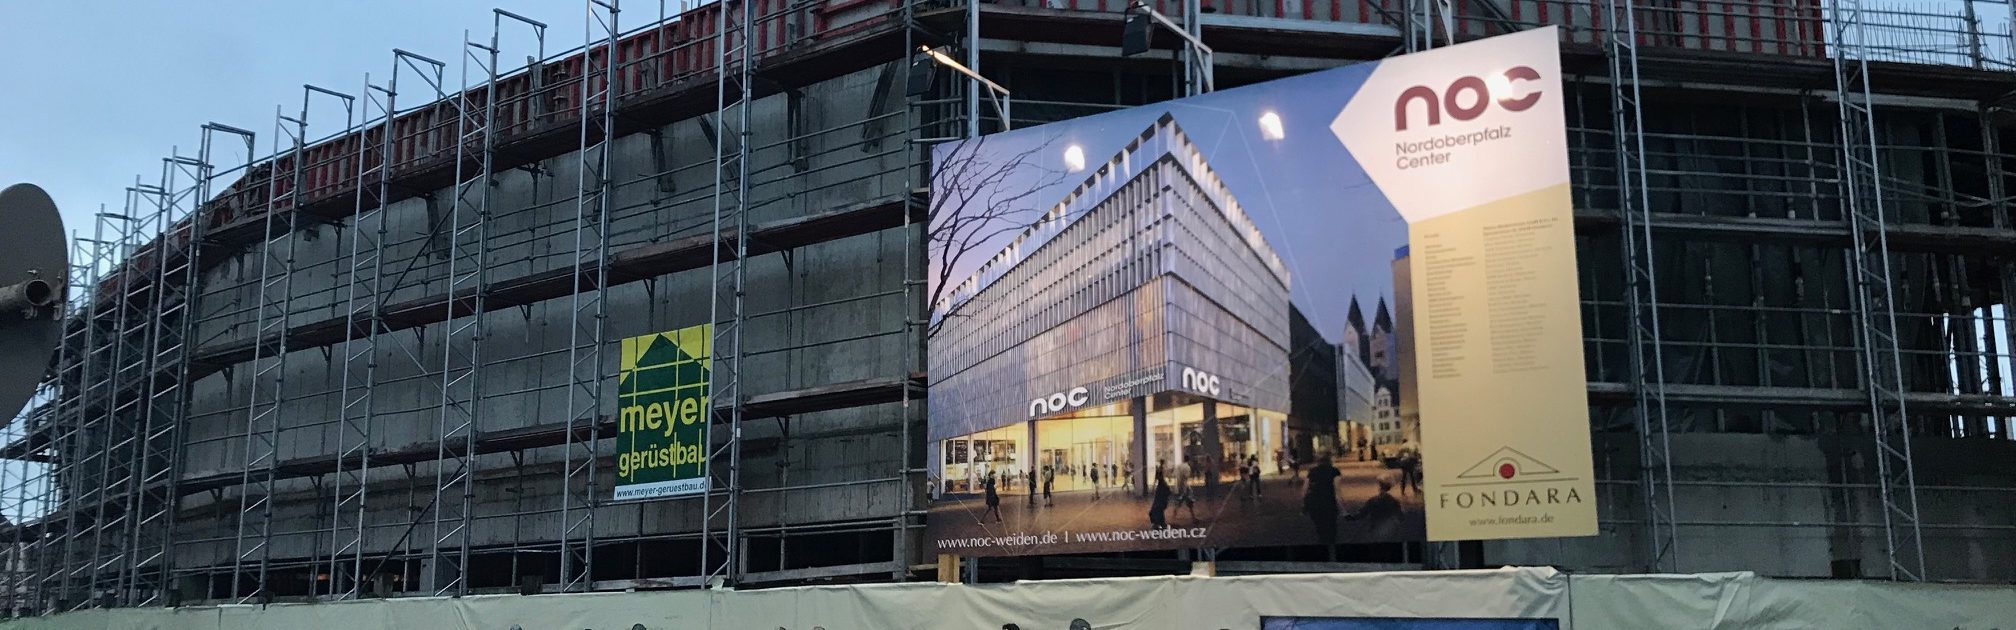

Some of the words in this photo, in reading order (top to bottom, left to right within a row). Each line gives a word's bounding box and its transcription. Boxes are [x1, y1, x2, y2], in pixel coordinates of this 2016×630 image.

[1394, 65, 1543, 132] noc
[1395, 126, 1512, 155] Nordoberpfalz
[1396, 151, 1451, 170] Center
[1182, 366, 1220, 396] noc
[1029, 386, 1089, 417] noc
[620, 395, 709, 437] meyer
[616, 481, 706, 498] www.meyer-geruestbau.d
[1439, 486, 1582, 509] FONDARA
[1468, 512, 1554, 527] www.fondara.de
[937, 530, 1058, 549] www.noc-weiden.de
[1076, 524, 1207, 543] www.noc-weiden.cz
